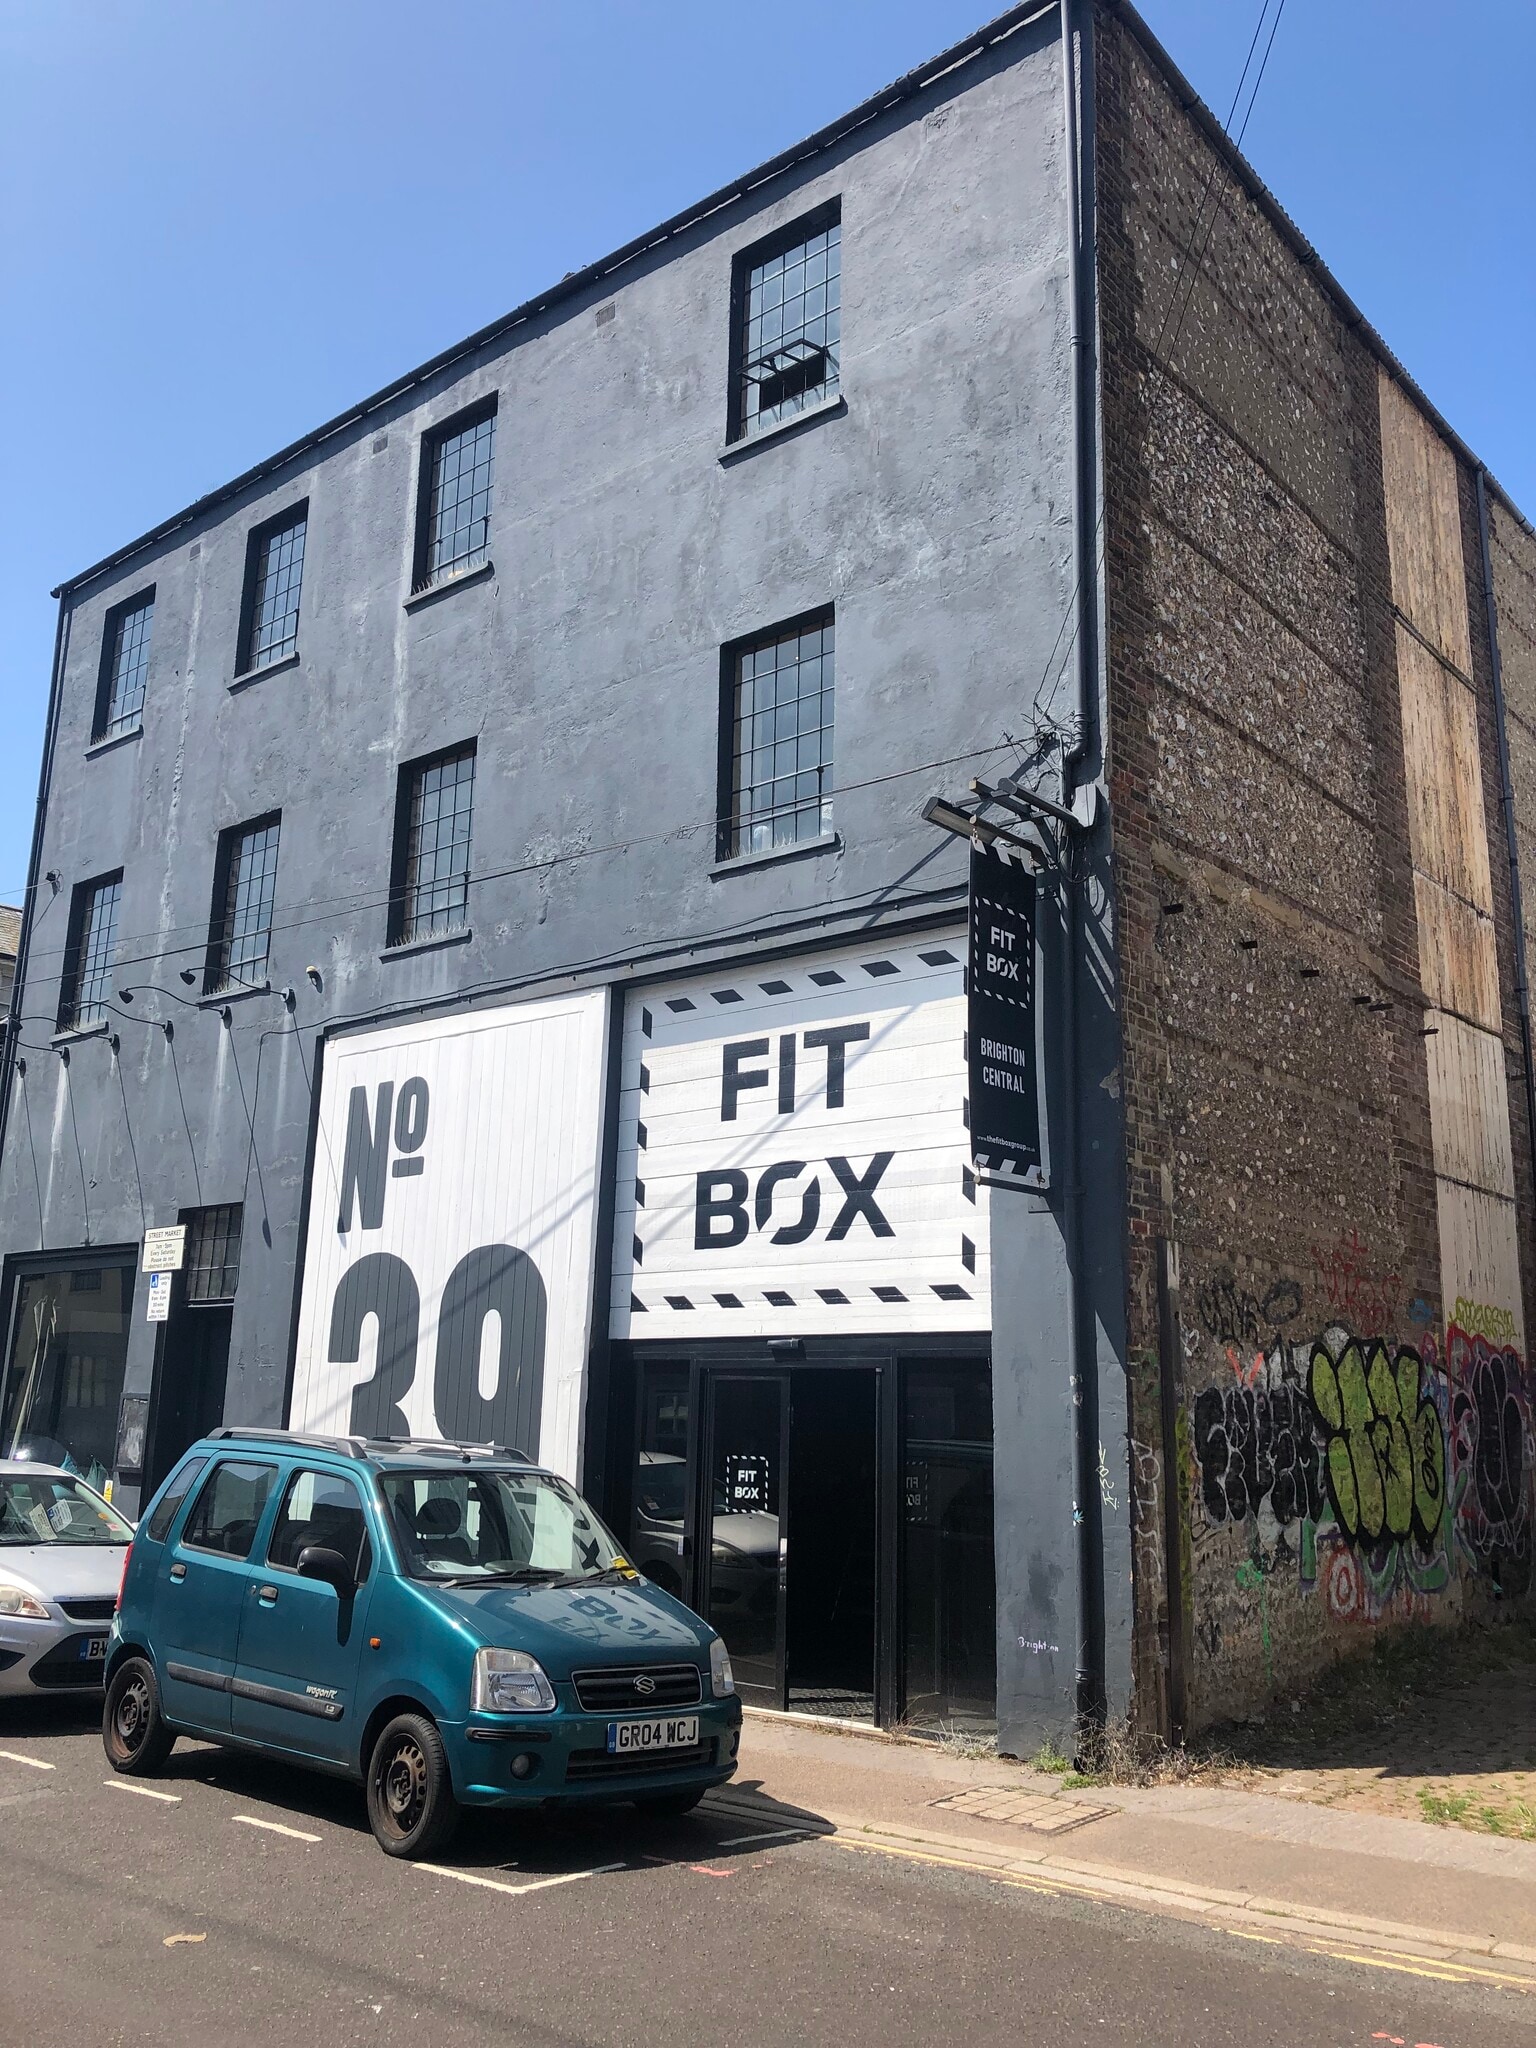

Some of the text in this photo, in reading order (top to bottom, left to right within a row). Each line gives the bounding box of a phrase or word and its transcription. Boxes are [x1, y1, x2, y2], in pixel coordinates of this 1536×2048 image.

[990, 925, 1016, 952] FIT
[986, 952, 1019, 982] BOX
[980, 1037, 1026, 1068] BRIGHTON
[721, 1021, 871, 1122] FIT
[982, 1065, 1026, 1095] CENTRAL
[694, 1150, 897, 1250] BOX
[149, 1229, 182, 1239] STREET MARKET
[737, 1469, 757, 1482] FIT
[734, 1486, 760, 1500] BOX
[619, 1719, 697, 1748] GR04 WCJ
